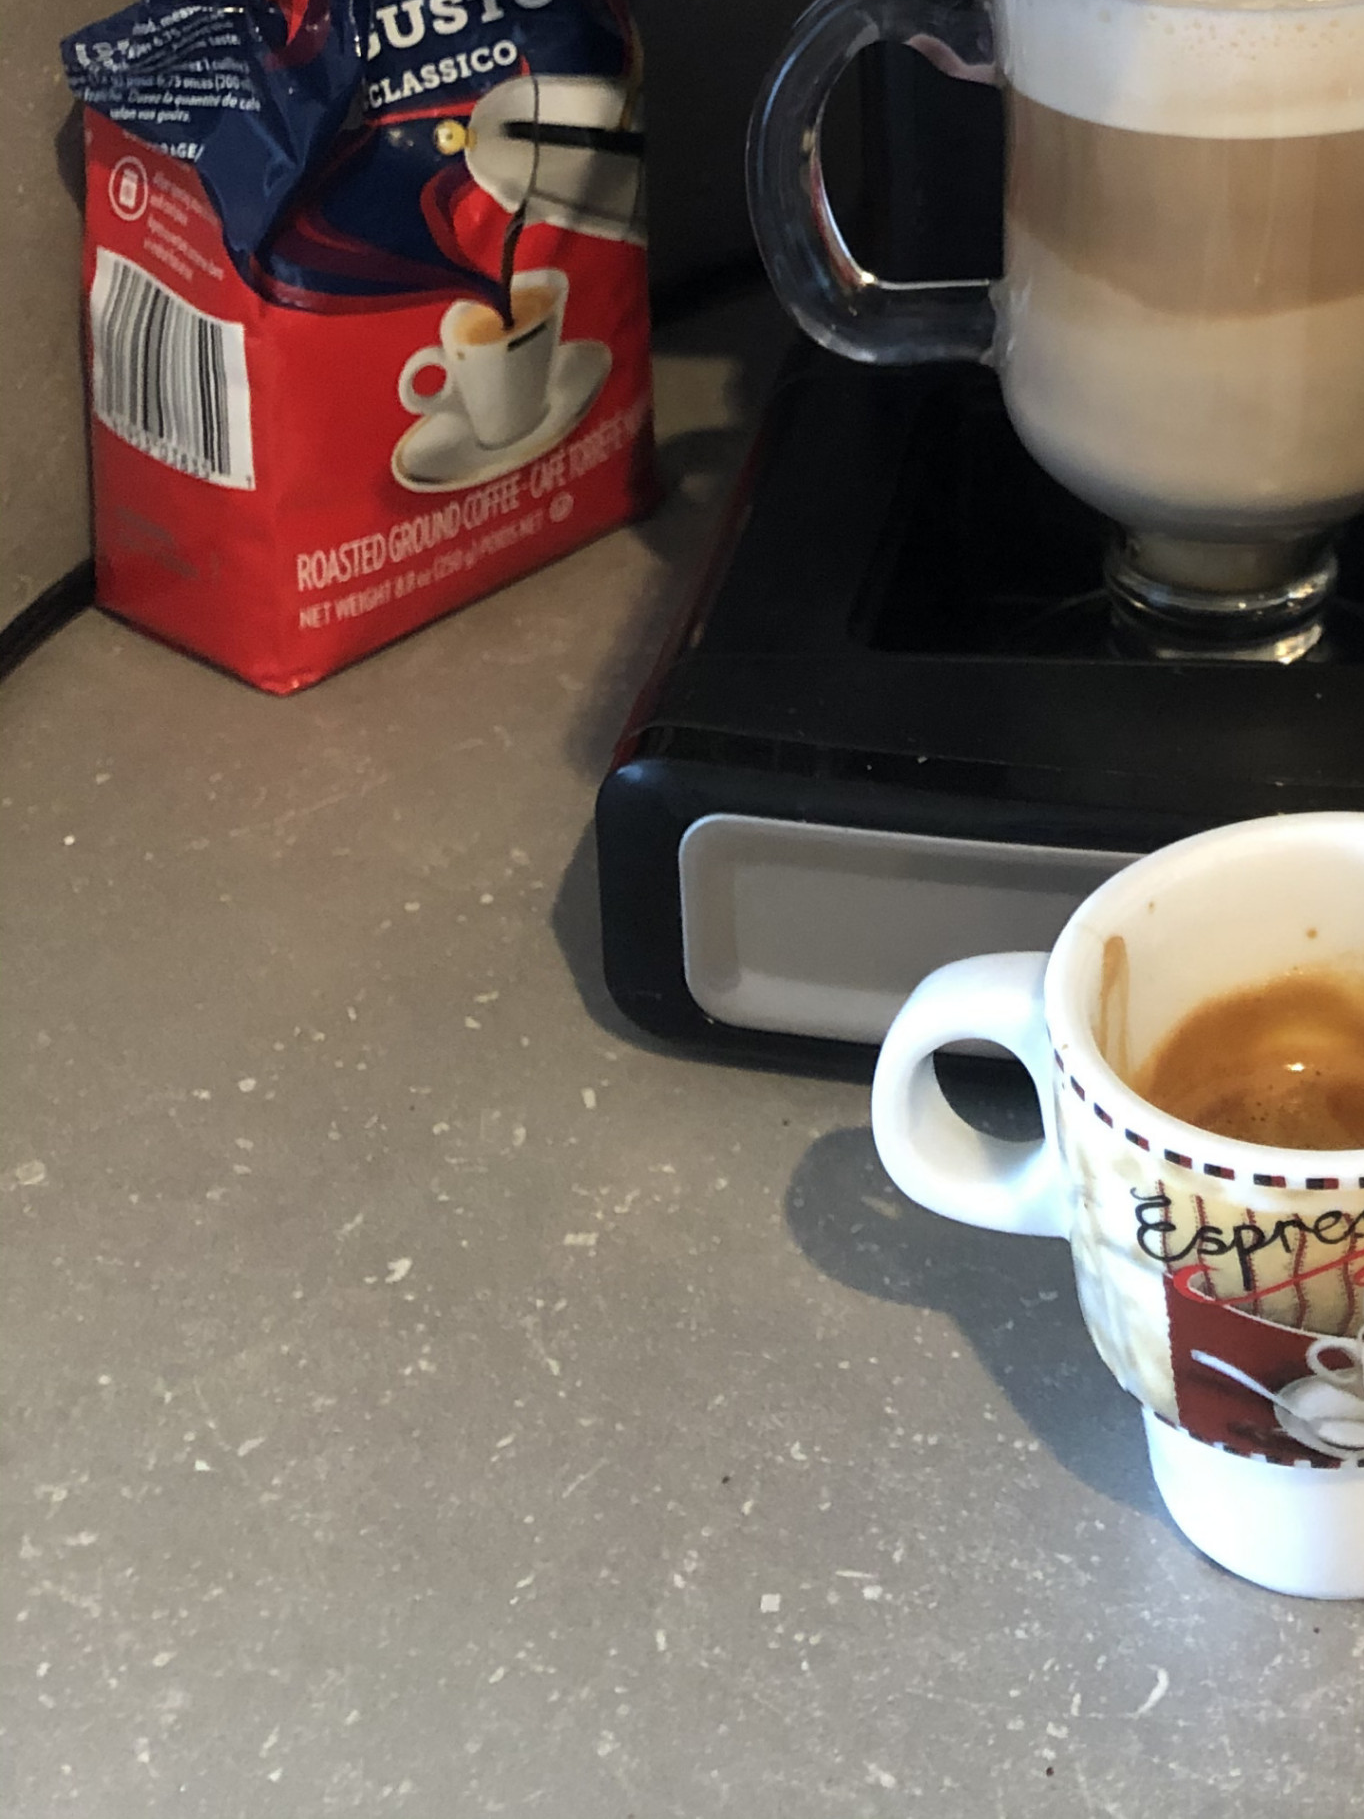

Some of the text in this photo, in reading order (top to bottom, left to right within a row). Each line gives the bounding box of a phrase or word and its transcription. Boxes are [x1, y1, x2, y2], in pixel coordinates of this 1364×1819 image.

[368, 39, 519, 109] CLASSICO
[297, 532, 387, 592] ROASTED
[388, 500, 461, 563] GROUND
[463, 470, 521, 530] COFFEE
[299, 600, 332, 629] NET
[334, 579, 392, 621] WEIGHT
